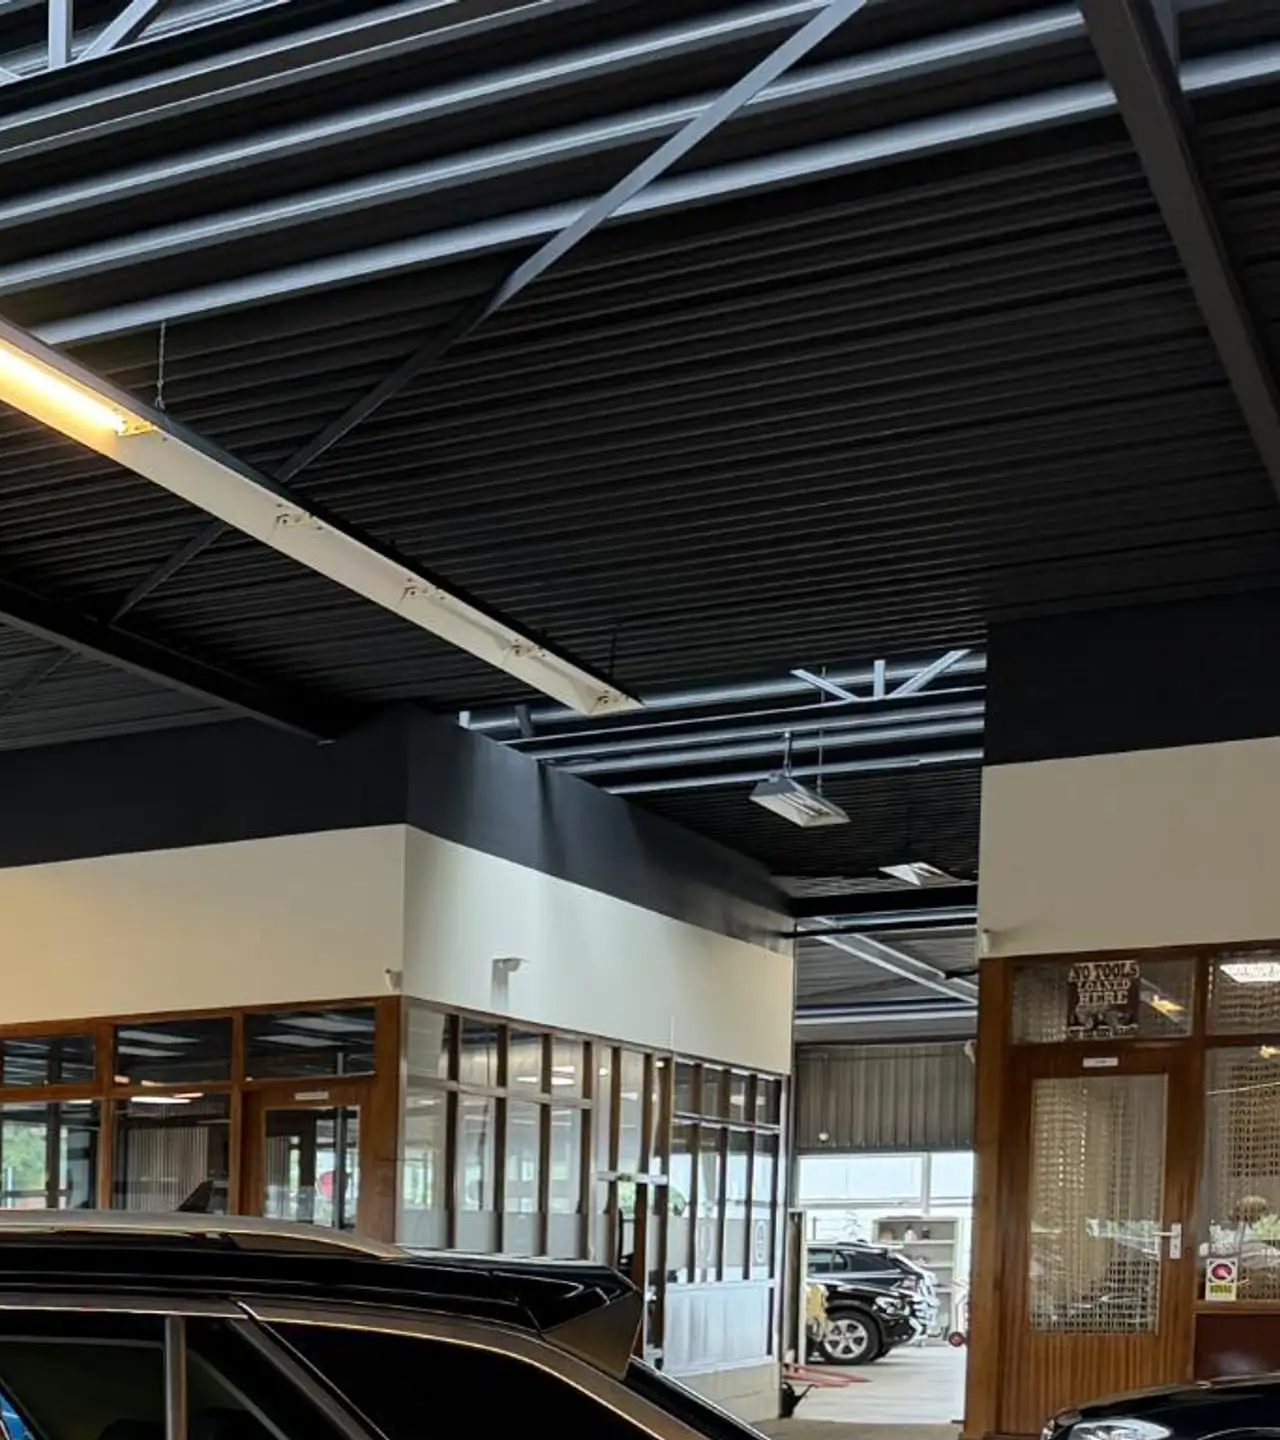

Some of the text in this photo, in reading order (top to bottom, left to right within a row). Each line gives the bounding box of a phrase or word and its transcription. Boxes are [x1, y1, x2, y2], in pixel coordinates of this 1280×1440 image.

[1068, 961, 1140, 982] NO TOOLS
[1077, 980, 1132, 993] LOANED
[1078, 991, 1128, 1006] HERE
